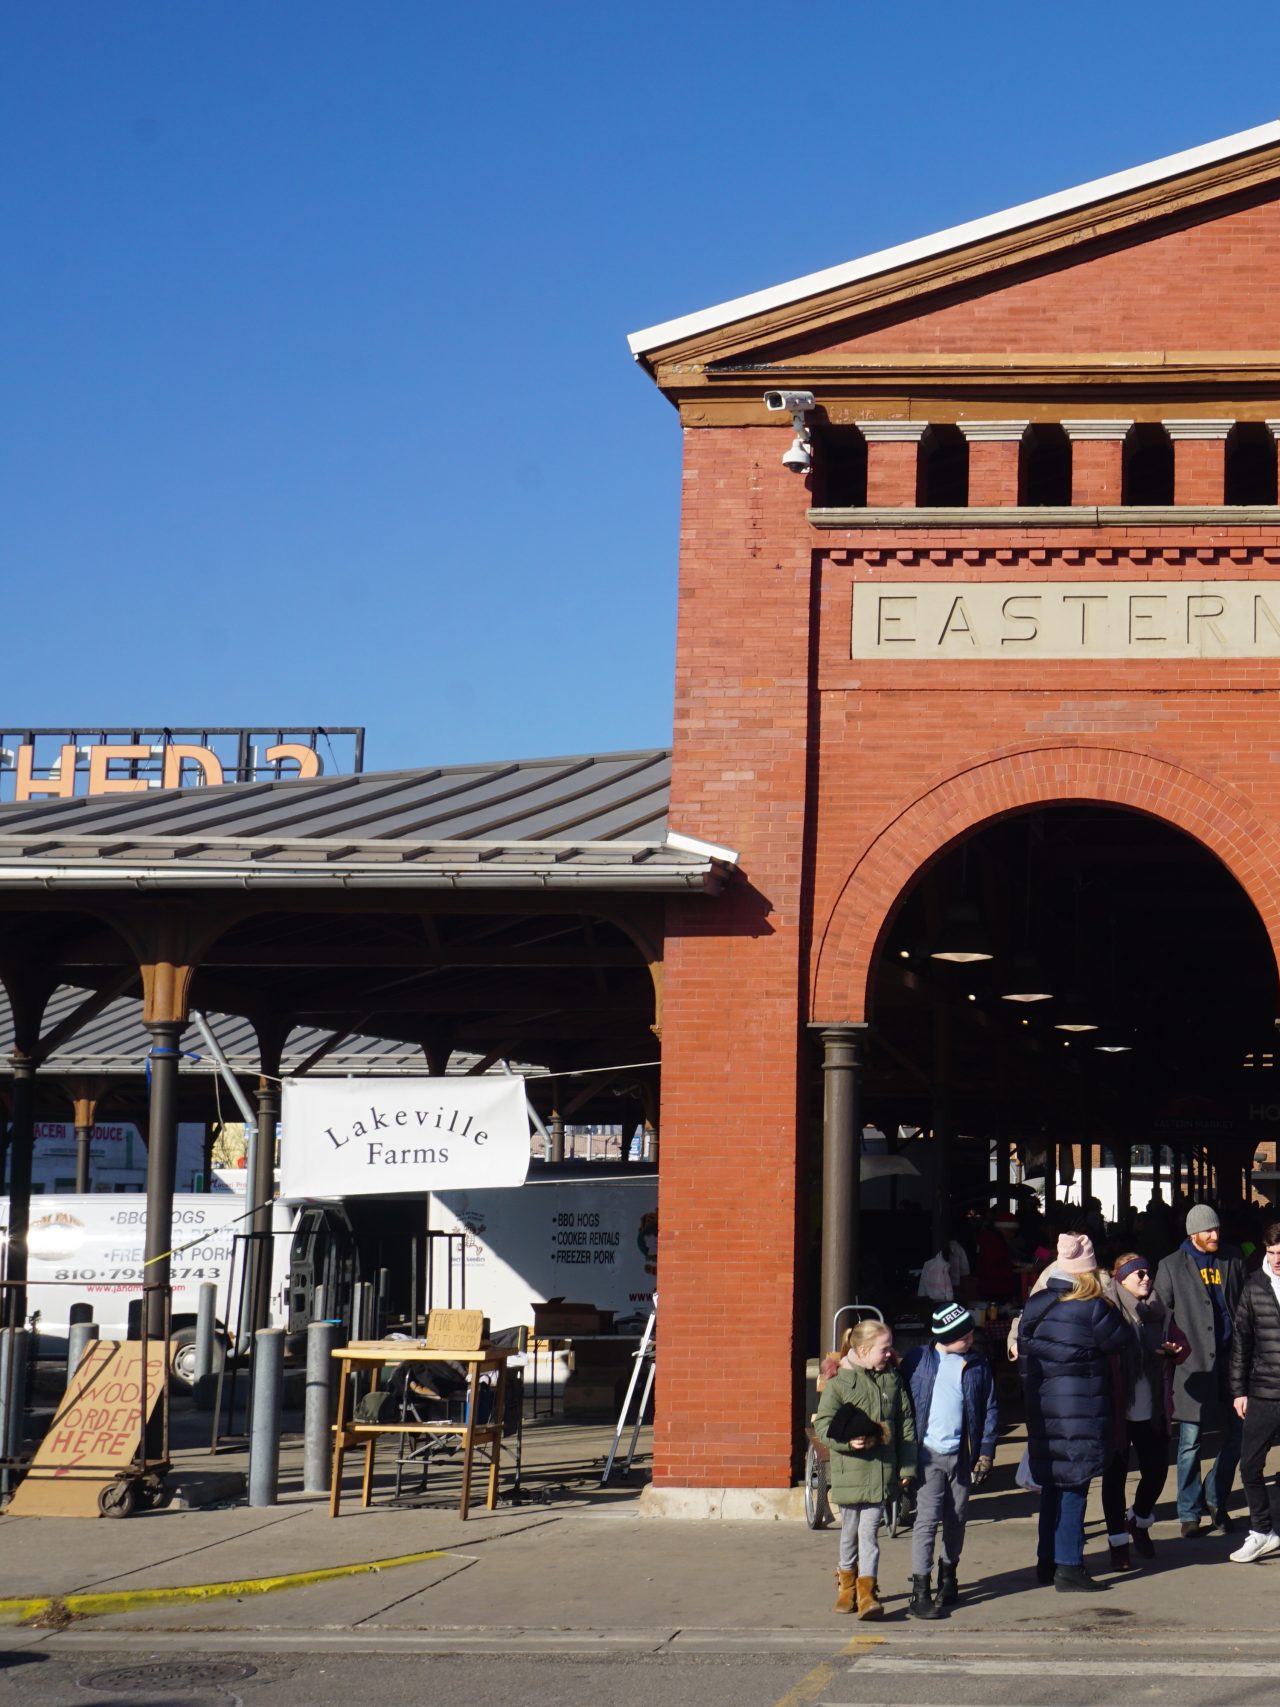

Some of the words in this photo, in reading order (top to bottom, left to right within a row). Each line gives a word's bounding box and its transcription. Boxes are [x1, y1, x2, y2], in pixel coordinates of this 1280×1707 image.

[323, 1106, 489, 1150] Lakeville
[366, 1142, 449, 1165] Farms
[557, 1213, 575, 1227] BBQ
[577, 1213, 600, 1227] HOGS
[557, 1231, 587, 1246] COOKER
[589, 1231, 620, 1246] RENTALS
[191, 1247, 234, 1261] PORK
[556, 1250, 591, 1264] FREEZER
[593, 1250, 615, 1264] PORK
[64, 1408, 143, 1432] ORDER
[50, 1430, 131, 1456] HERE
